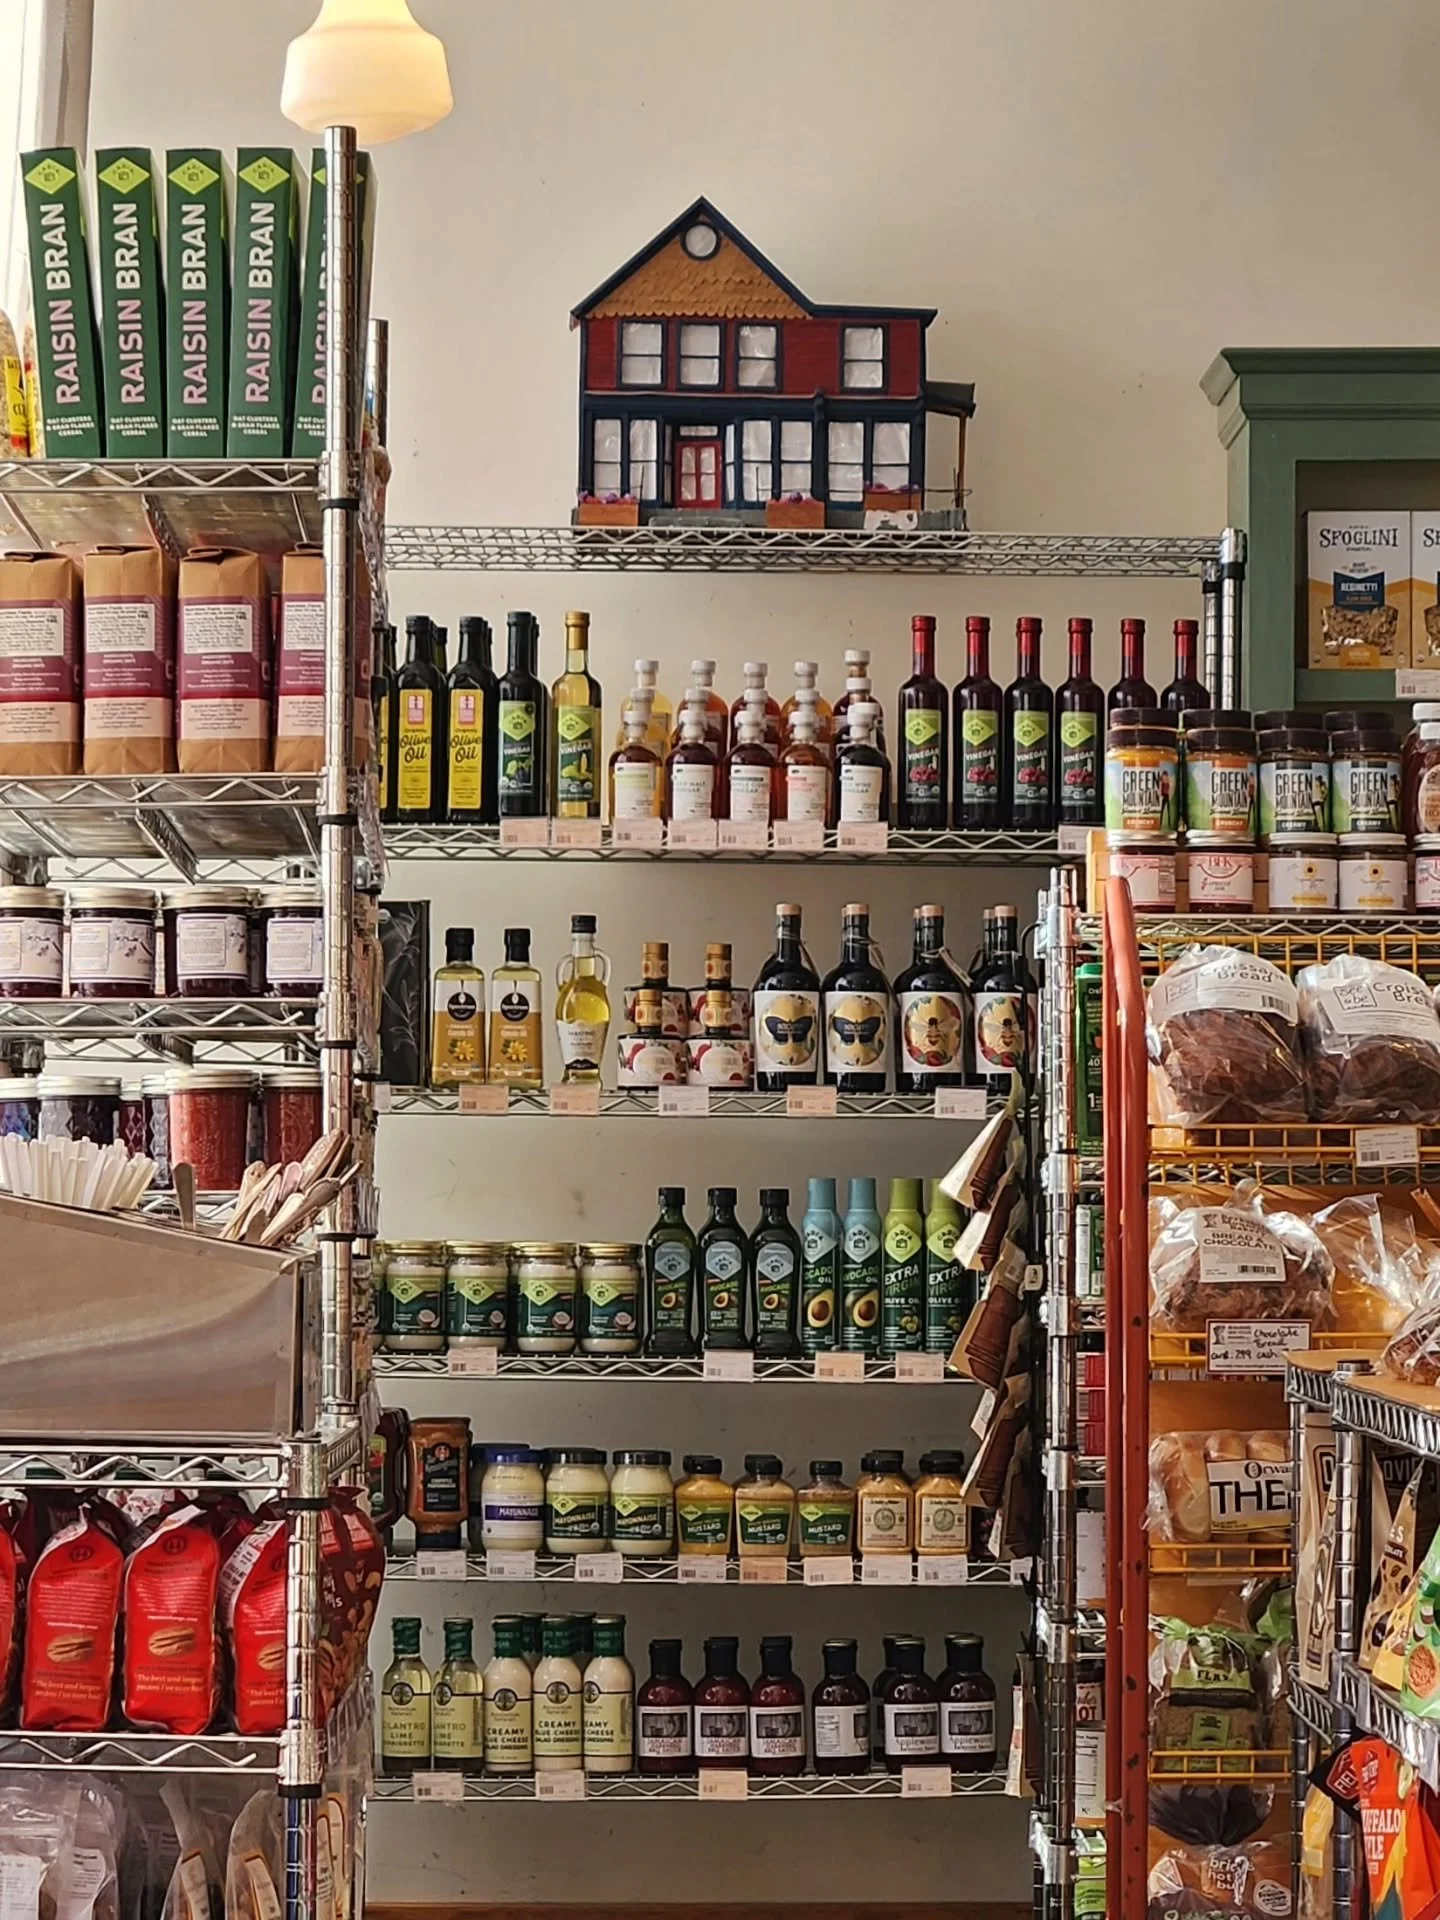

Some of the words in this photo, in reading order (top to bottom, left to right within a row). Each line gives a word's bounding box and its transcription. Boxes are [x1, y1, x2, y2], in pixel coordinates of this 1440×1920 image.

[40, 203, 72, 290] BRAN
[113, 203, 141, 290] BRAN
[182, 204, 207, 290] BRAN
[249, 202, 275, 289] BRAN
[49, 299, 81, 404] RAISIN
[118, 299, 146, 404] RAISIN
[183, 300, 208, 404] RAISIN
[245, 299, 272, 403] RAISIN
[400, 734, 431, 748] Olive
[450, 734, 481, 748] Olive
[404, 746, 427, 764] Oil
[455, 746, 478, 763] Oil
[1122, 771, 1160, 793] GREEN
[1211, 771, 1248, 794] GREEN
[1275, 772, 1312, 796] GREEN
[1350, 771, 1388, 794] GREEN
[1200, 963, 1285, 981] Croissant
[1218, 970, 1272, 982] Bread
[1204, 1238, 1276, 1251] CHOCOLATE
[1212, 1232, 1253, 1241] BREAD
[884, 1264, 919, 1285] EXTRA
[1254, 1328, 1299, 1338] Chocolate
[688, 1522, 722, 1532] MUSTARD
[748, 1522, 782, 1533] MUSTARD
[808, 1523, 841, 1533] MUSTARD
[487, 1727, 525, 1736] CREAMY
[538, 1720, 576, 1729] CREAMY
[1208, 1869, 1232, 1880] hot
